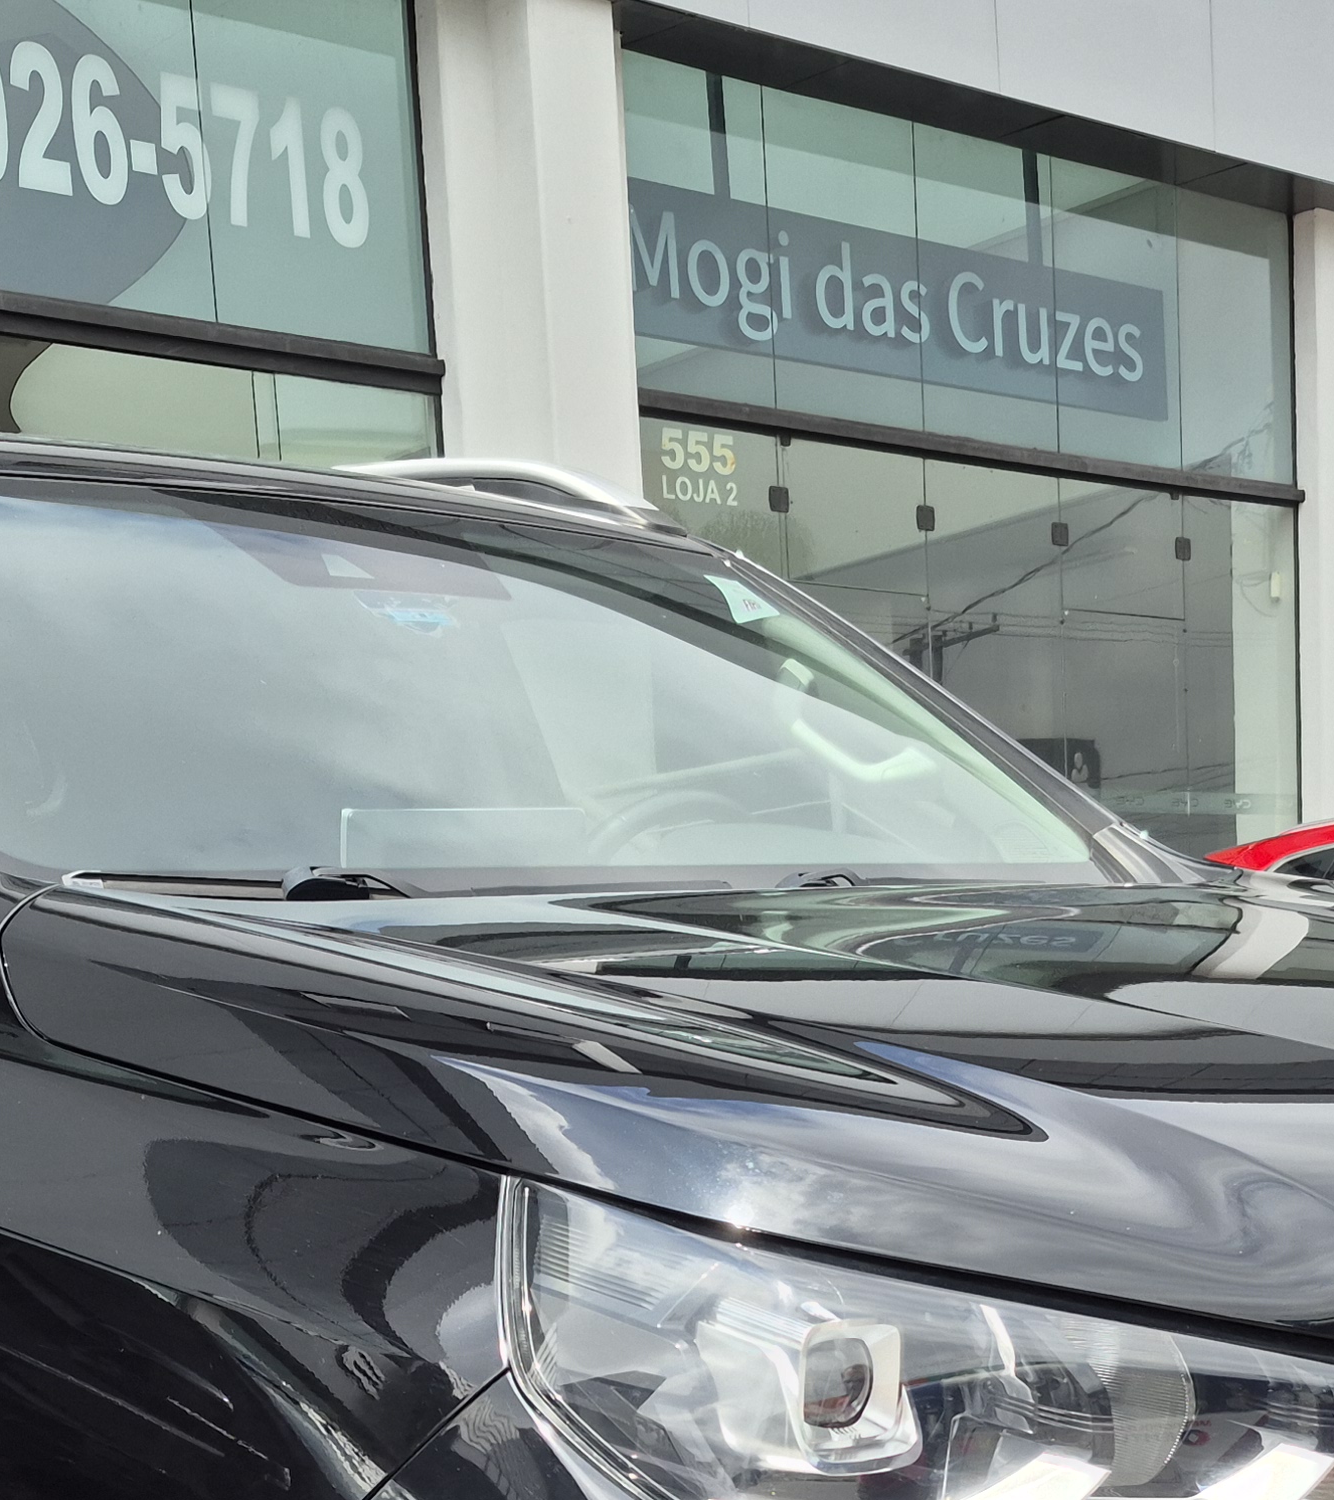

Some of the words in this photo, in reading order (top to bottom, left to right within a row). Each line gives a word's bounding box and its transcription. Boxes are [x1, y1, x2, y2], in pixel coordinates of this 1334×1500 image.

[629, 203, 792, 341] Mogi
[816, 242, 929, 344] das
[948, 272, 1144, 382] Cruzes
[661, 427, 736, 476] 555
[661, 474, 722, 505] LOJA
[725, 482, 739, 506] 2
